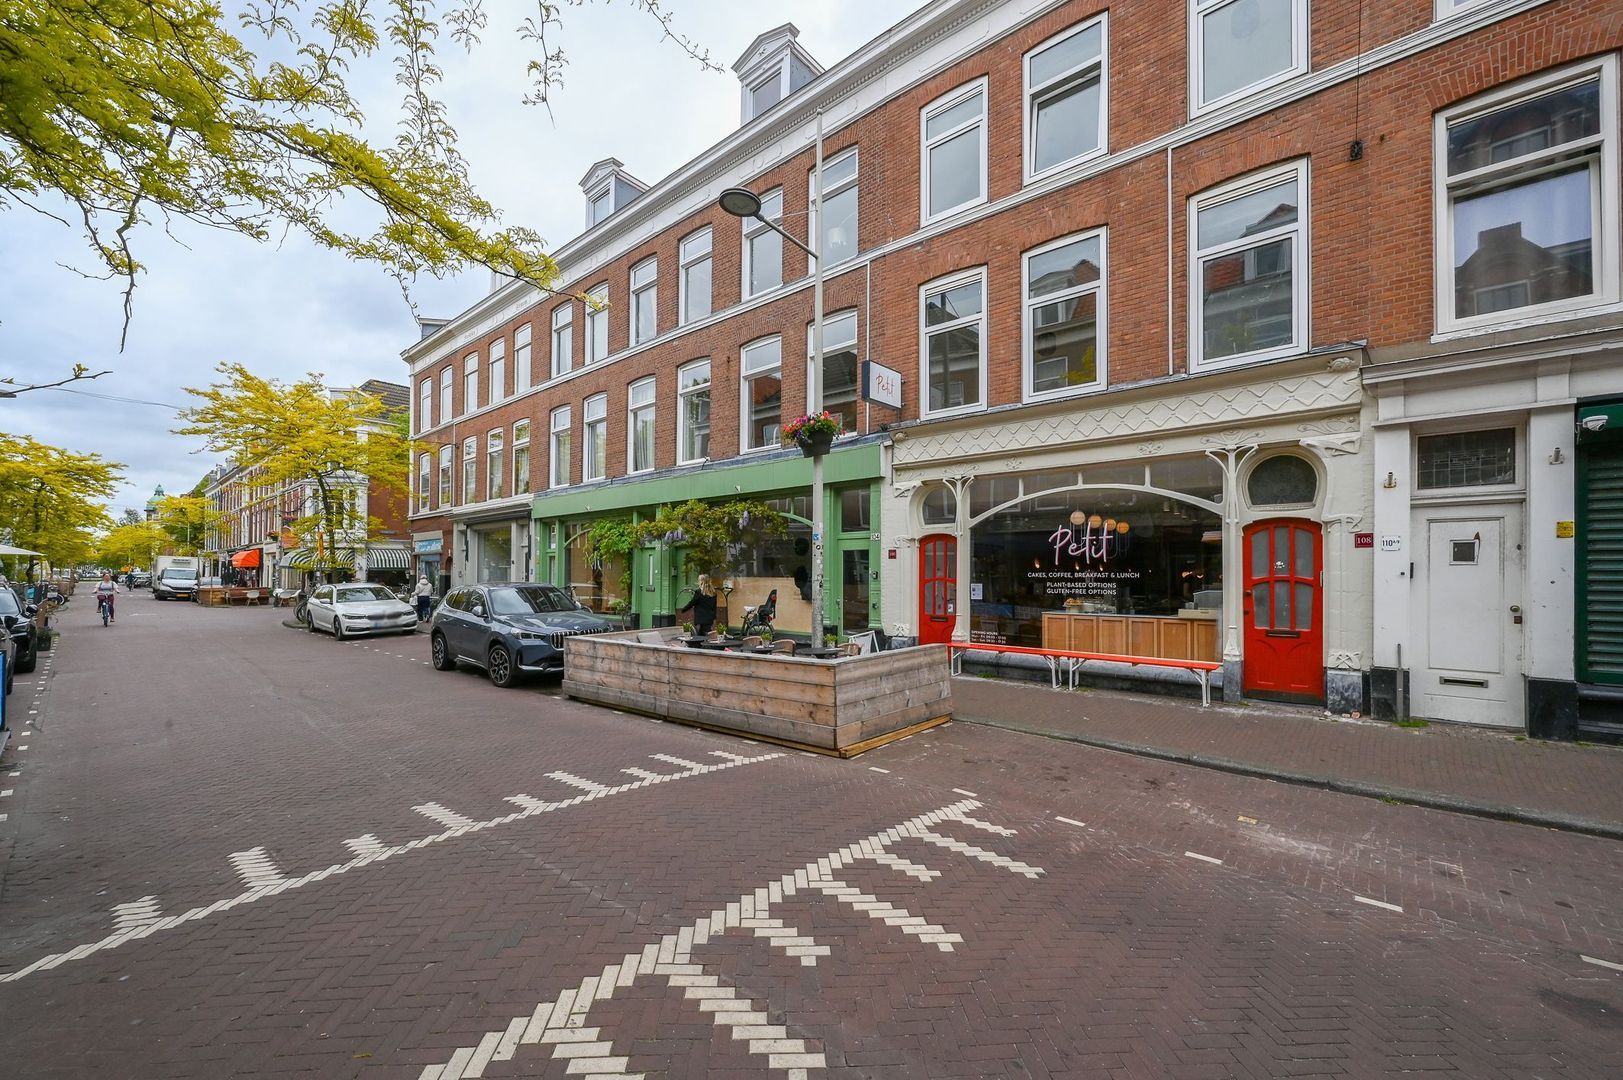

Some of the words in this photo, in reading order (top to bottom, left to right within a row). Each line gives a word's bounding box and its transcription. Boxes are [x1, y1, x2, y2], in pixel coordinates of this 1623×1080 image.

[876, 372, 894, 397] Petit
[1048, 521, 1113, 565] Petit
[1357, 536, 1371, 544] 108
